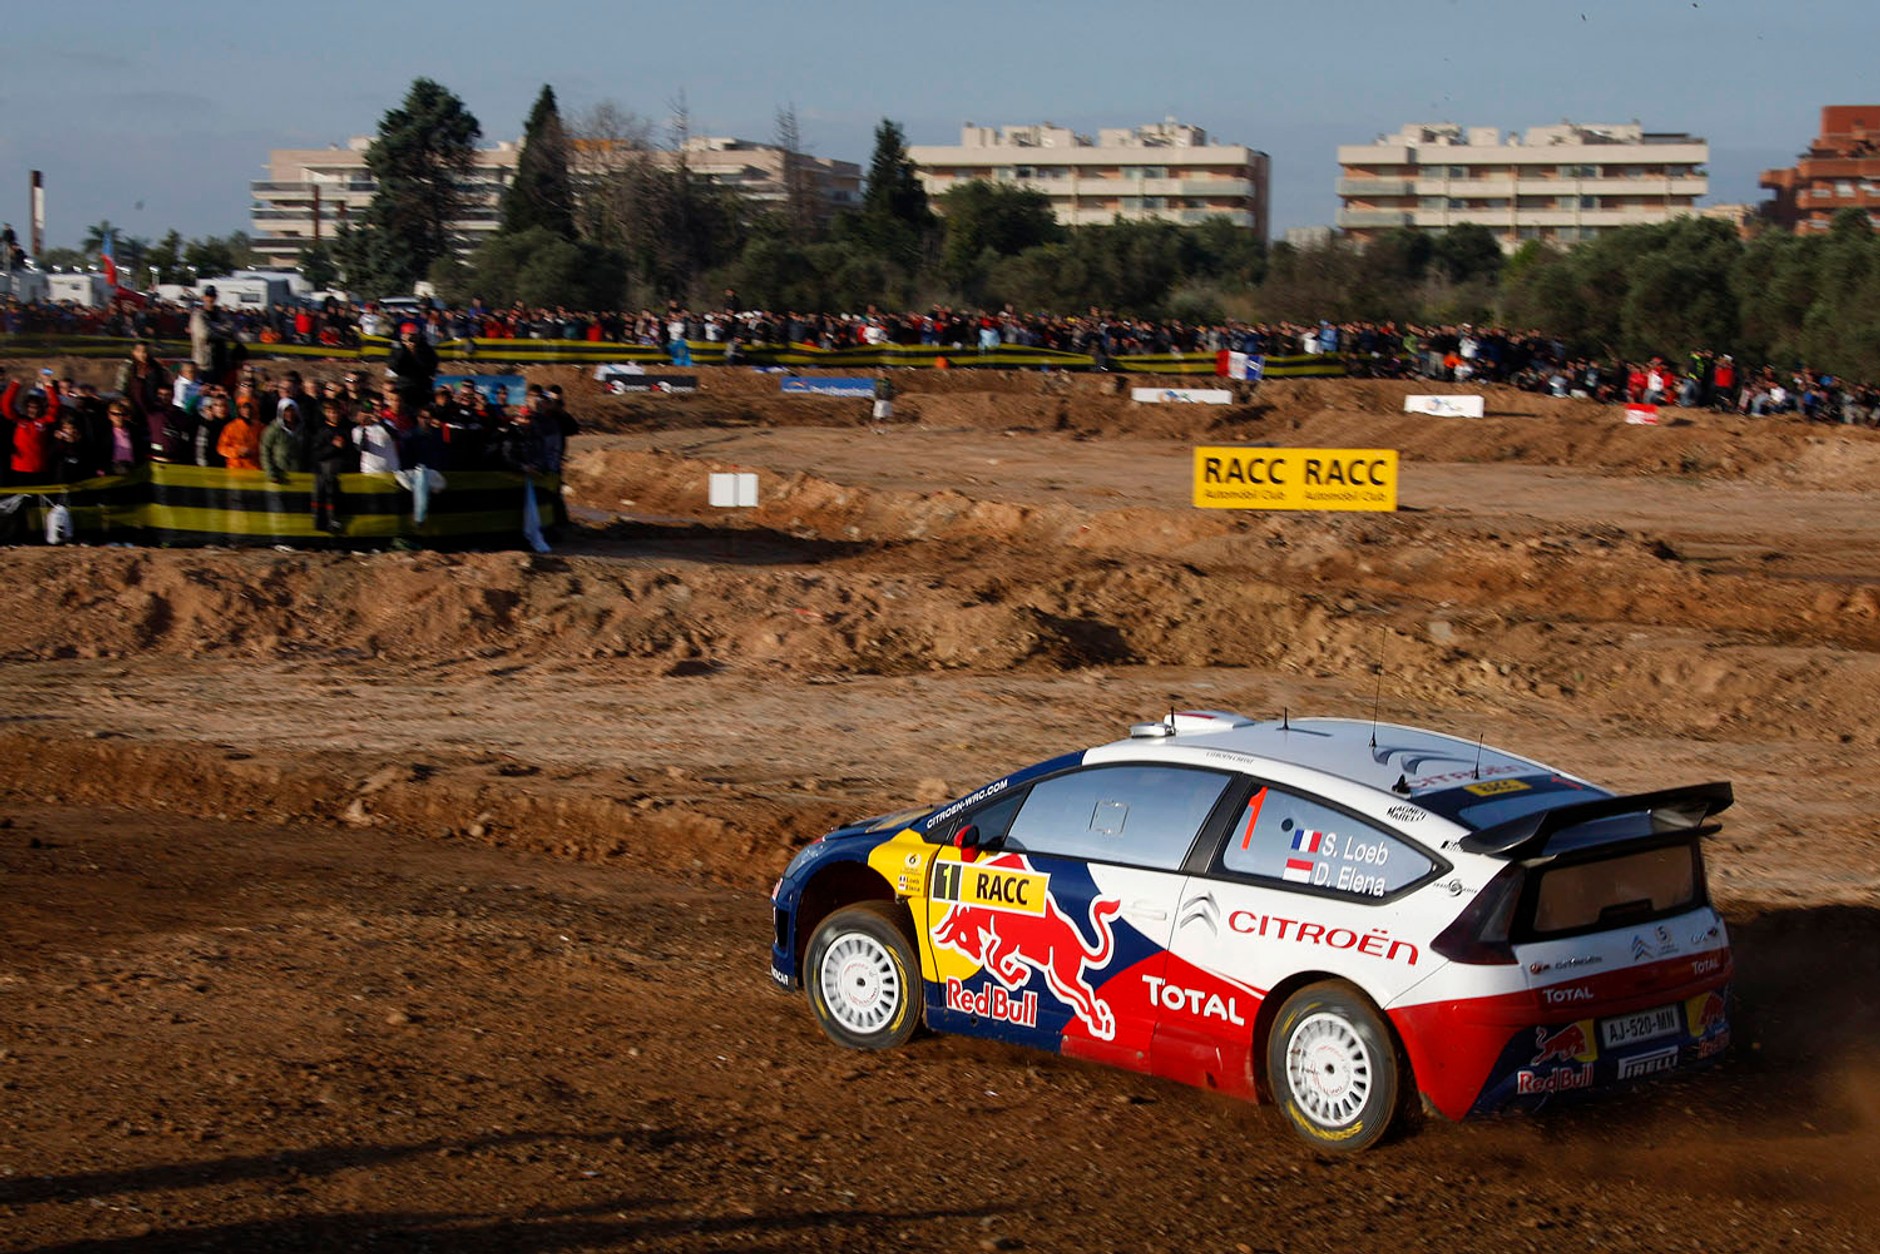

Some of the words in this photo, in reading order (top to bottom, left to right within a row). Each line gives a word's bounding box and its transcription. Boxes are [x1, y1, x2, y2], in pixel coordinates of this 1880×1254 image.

[1205, 457, 1287, 484] RACC
[1305, 459, 1387, 485] RACC
[1241, 787, 1269, 850] 1
[1322, 832, 1338, 858] S.
[1343, 836, 1388, 865] Loeb
[943, 864, 953, 900] 1
[976, 873, 1030, 905] RACC
[1313, 861, 1331, 887] D.
[1336, 866, 1386, 897] Elena
[1691, 959, 1720, 976] TOTAL
[946, 976, 991, 1018] Red
[992, 985, 1038, 1028] Bull
[1142, 974, 1245, 1027] TOTAL
[1543, 986, 1594, 1004] TOTAL
[1609, 1008, 1676, 1042] AJ-520-MN
[1517, 1067, 1557, 1095] Red
[1560, 1062, 1594, 1088] Bull
[1617, 1045, 1679, 1080] PIRELLI
